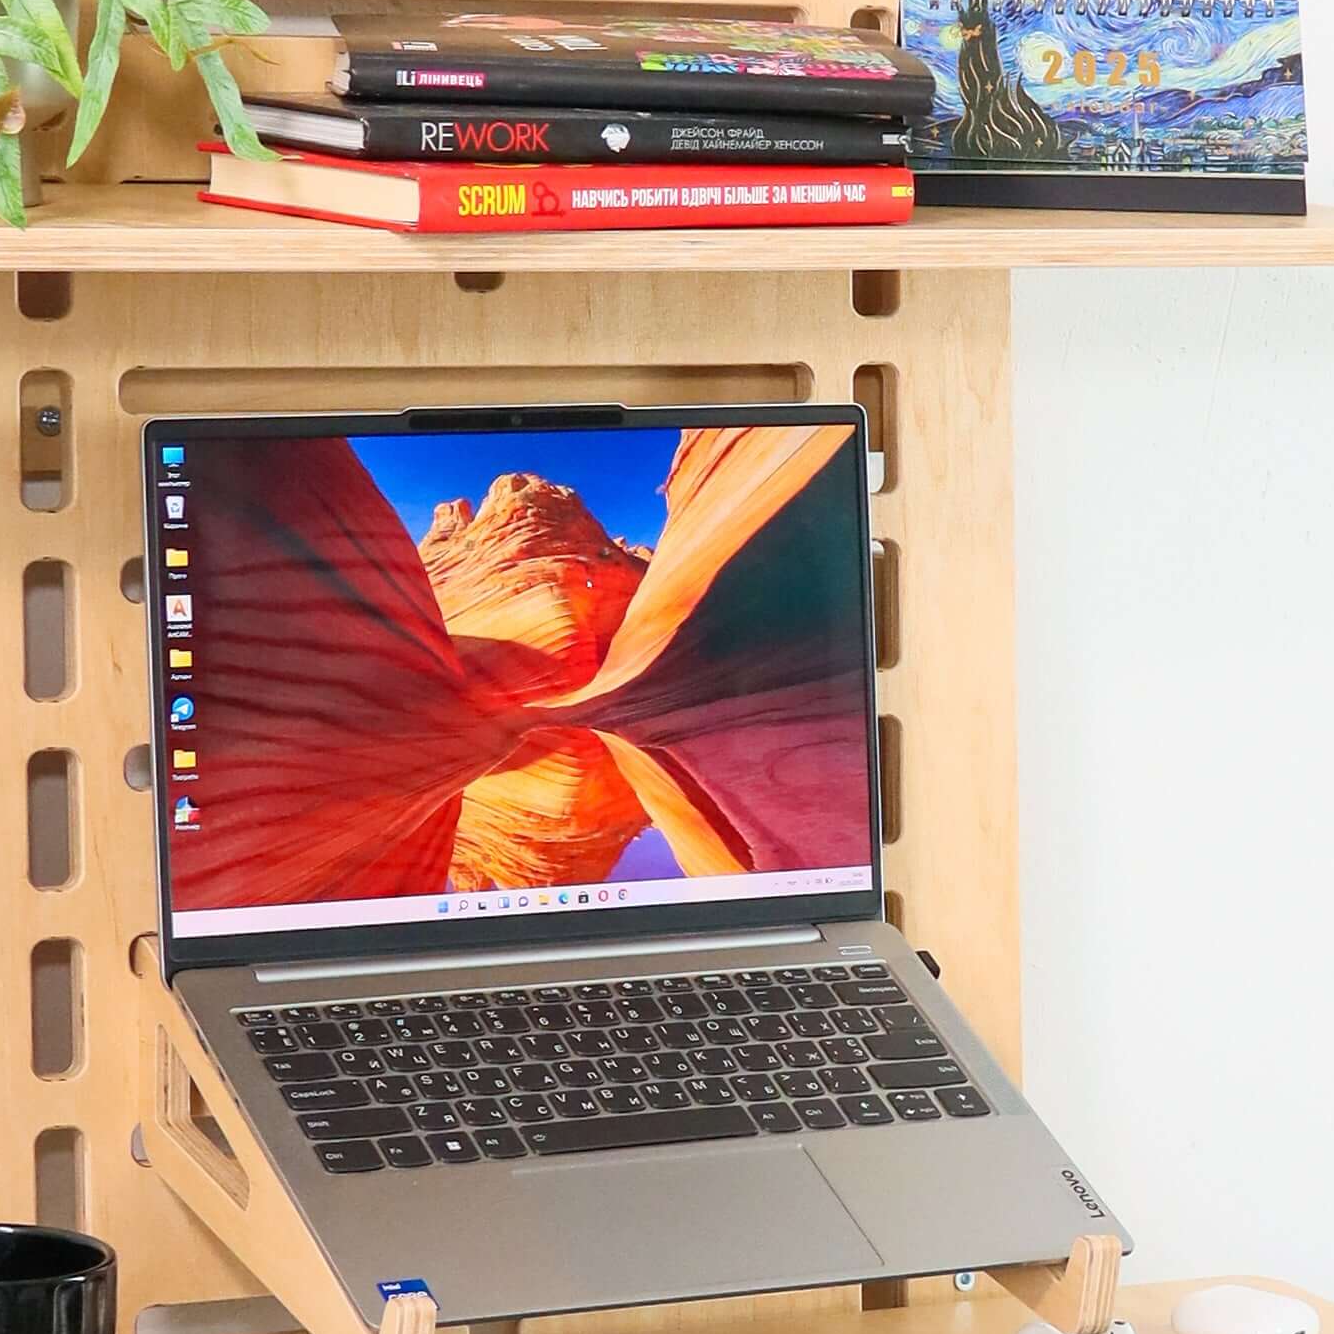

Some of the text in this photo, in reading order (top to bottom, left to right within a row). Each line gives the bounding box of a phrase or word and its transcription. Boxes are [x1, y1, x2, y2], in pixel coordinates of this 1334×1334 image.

[1042, 50, 1161, 86] 2025
[418, 73, 485, 88] ЛІНИВЕЦЬ
[421, 122, 550, 152] REWORK
[671, 127, 764, 139] ДЖЕЙСОН ФРАЙД
[670, 139, 700, 150] ДЕВІД
[572, 182, 866, 208] НАВЧИСЬ РОБИТИ ВДВІЧІ БІЛЬШЕ ЗА МЕНШИЙ ЧАС
[458, 185, 526, 216] SCRUM
[707, 1021, 720, 1031] O
[749, 1017, 760, 1027] P
[354, 1032, 366, 1042] 2
[400, 1028, 412, 1037] 3
[571, 1033, 582, 1042] Y
[616, 1029, 629, 1039] U
[526, 1036, 537, 1046] T
[387, 1048, 404, 1058] W
[434, 1044, 446, 1054] E
[738, 1048, 749, 1058] L
[651, 1055, 661, 1066] J
[694, 1051, 708, 1061] K
[559, 1063, 573, 1073] G
[603, 1059, 618, 1069] H
[466, 1071, 480, 1081] D
[512, 1067, 523, 1077] F
[375, 1079, 388, 1090] A
[420, 1075, 433, 1085] S
[690, 1080, 708, 1090] M
[600, 1089, 613, 1099] B
[645, 1085, 660, 1095] N
[509, 1097, 523, 1108] C
[554, 1093, 567, 1103] V
[416, 1106, 428, 1116] Z
[463, 1102, 476, 1112] X
[1061, 1170, 1105, 1218] Lenovo
